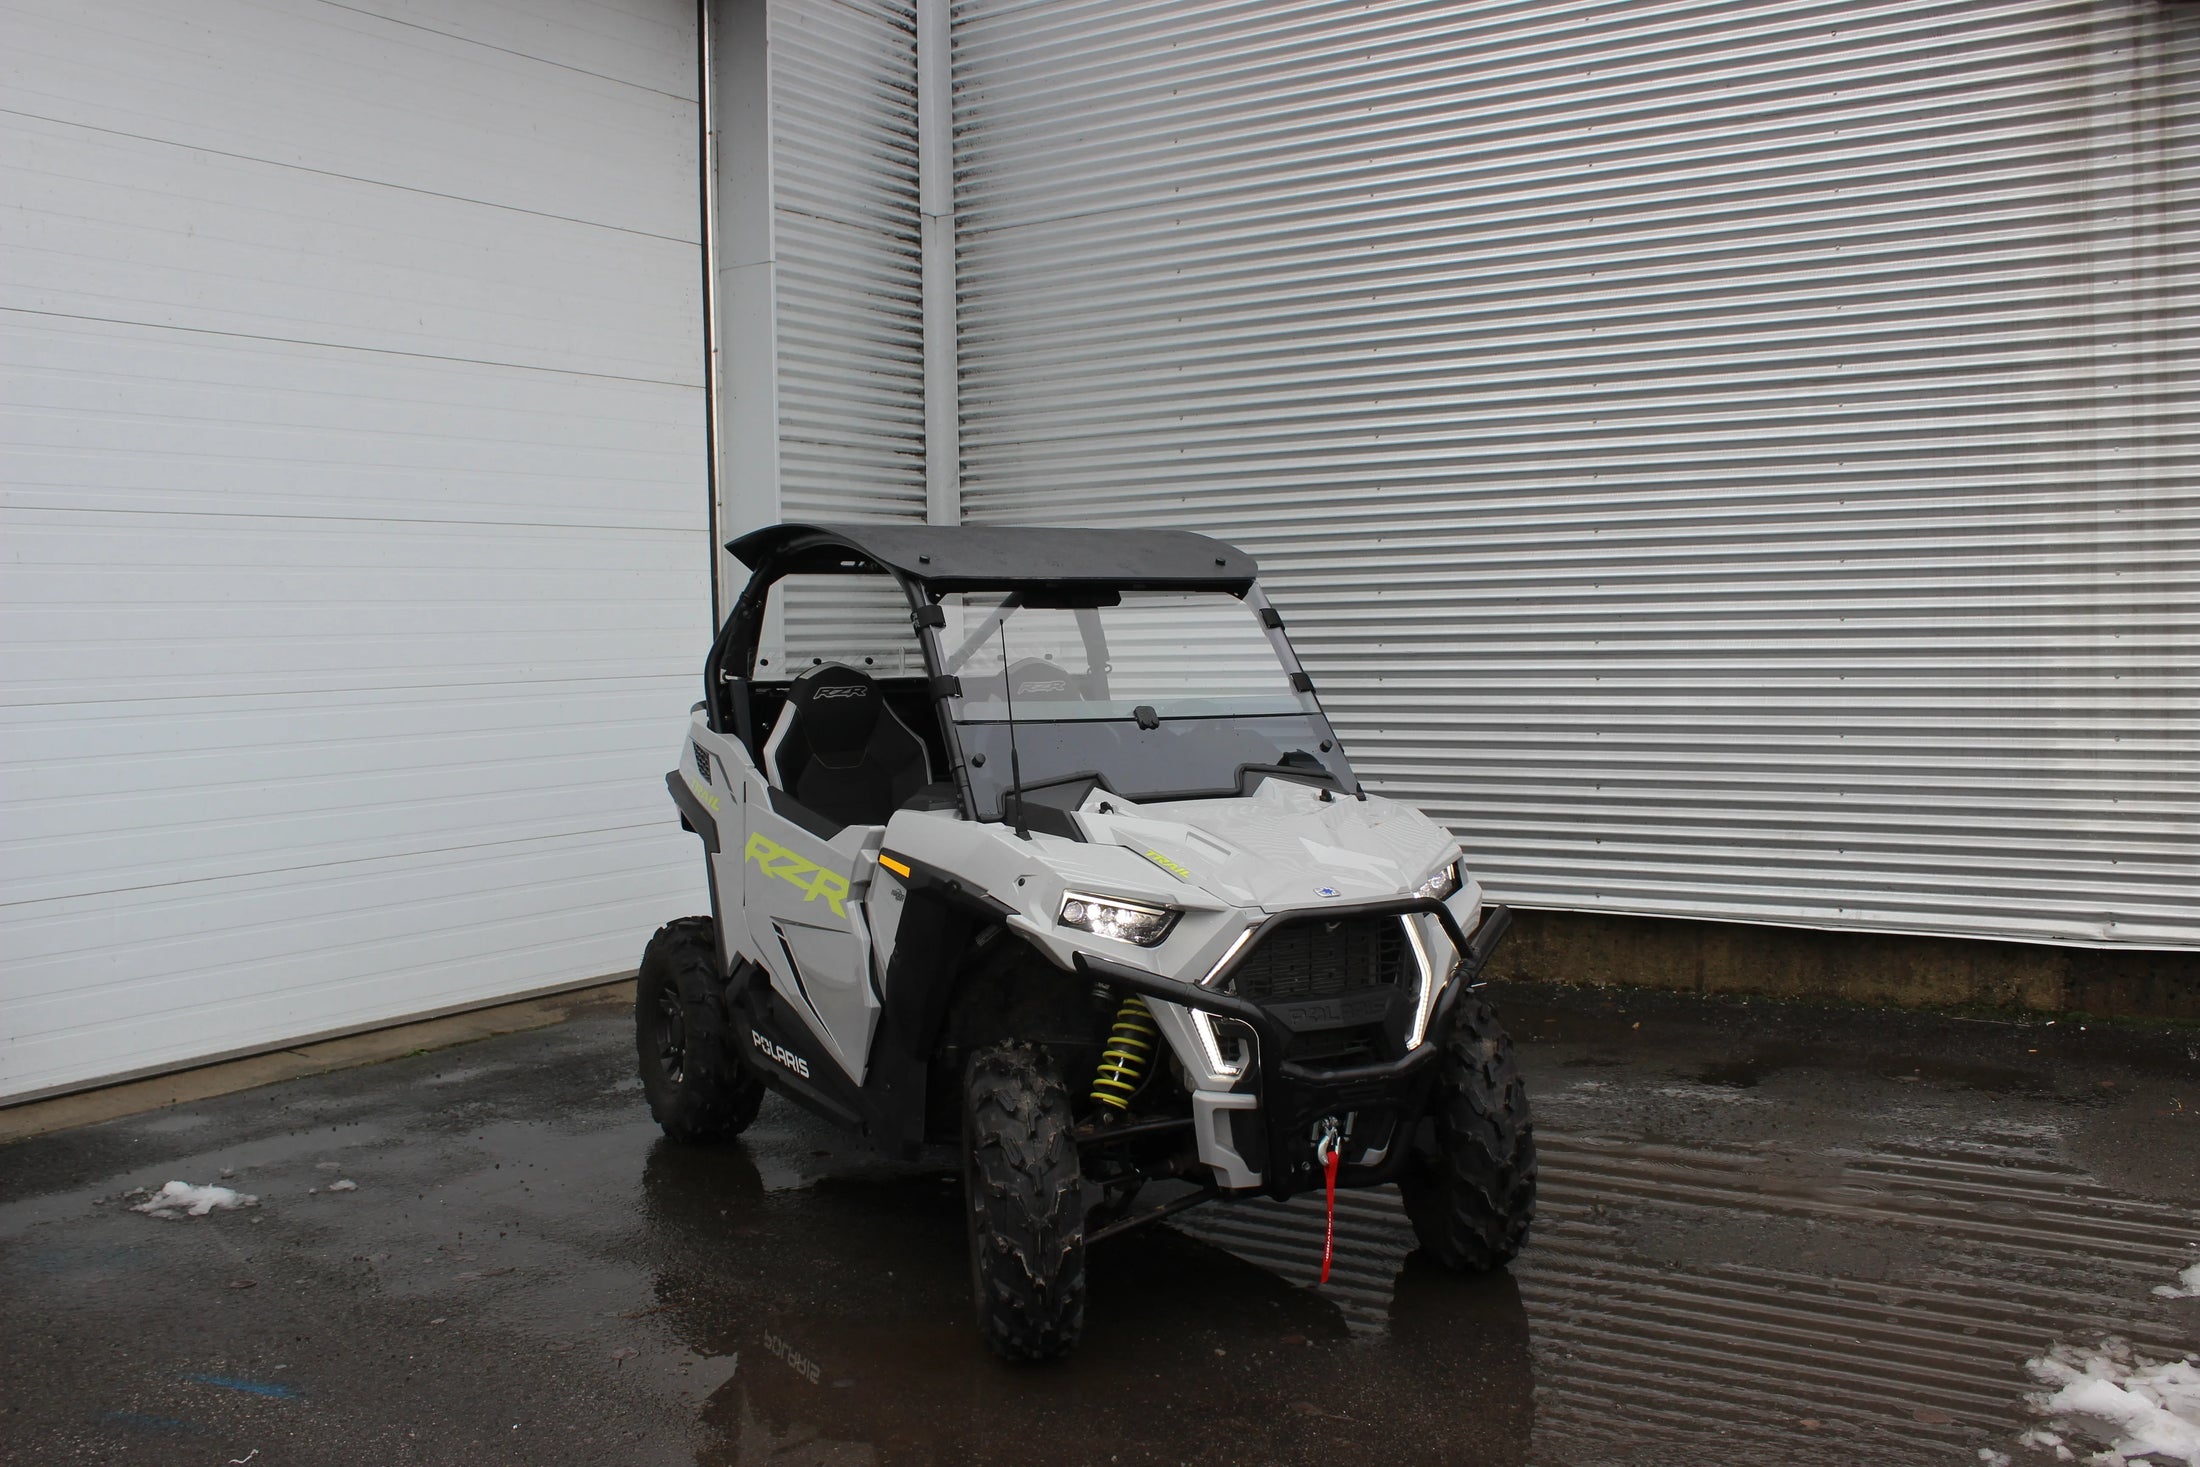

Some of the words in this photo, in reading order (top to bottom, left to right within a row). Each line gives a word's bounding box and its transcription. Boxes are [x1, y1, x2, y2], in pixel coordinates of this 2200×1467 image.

[812, 685, 868, 700] RZR
[744, 831, 850, 920] RZR
[1144, 850, 1190, 879] TRAIL
[751, 1029, 810, 1079] POLARIS
